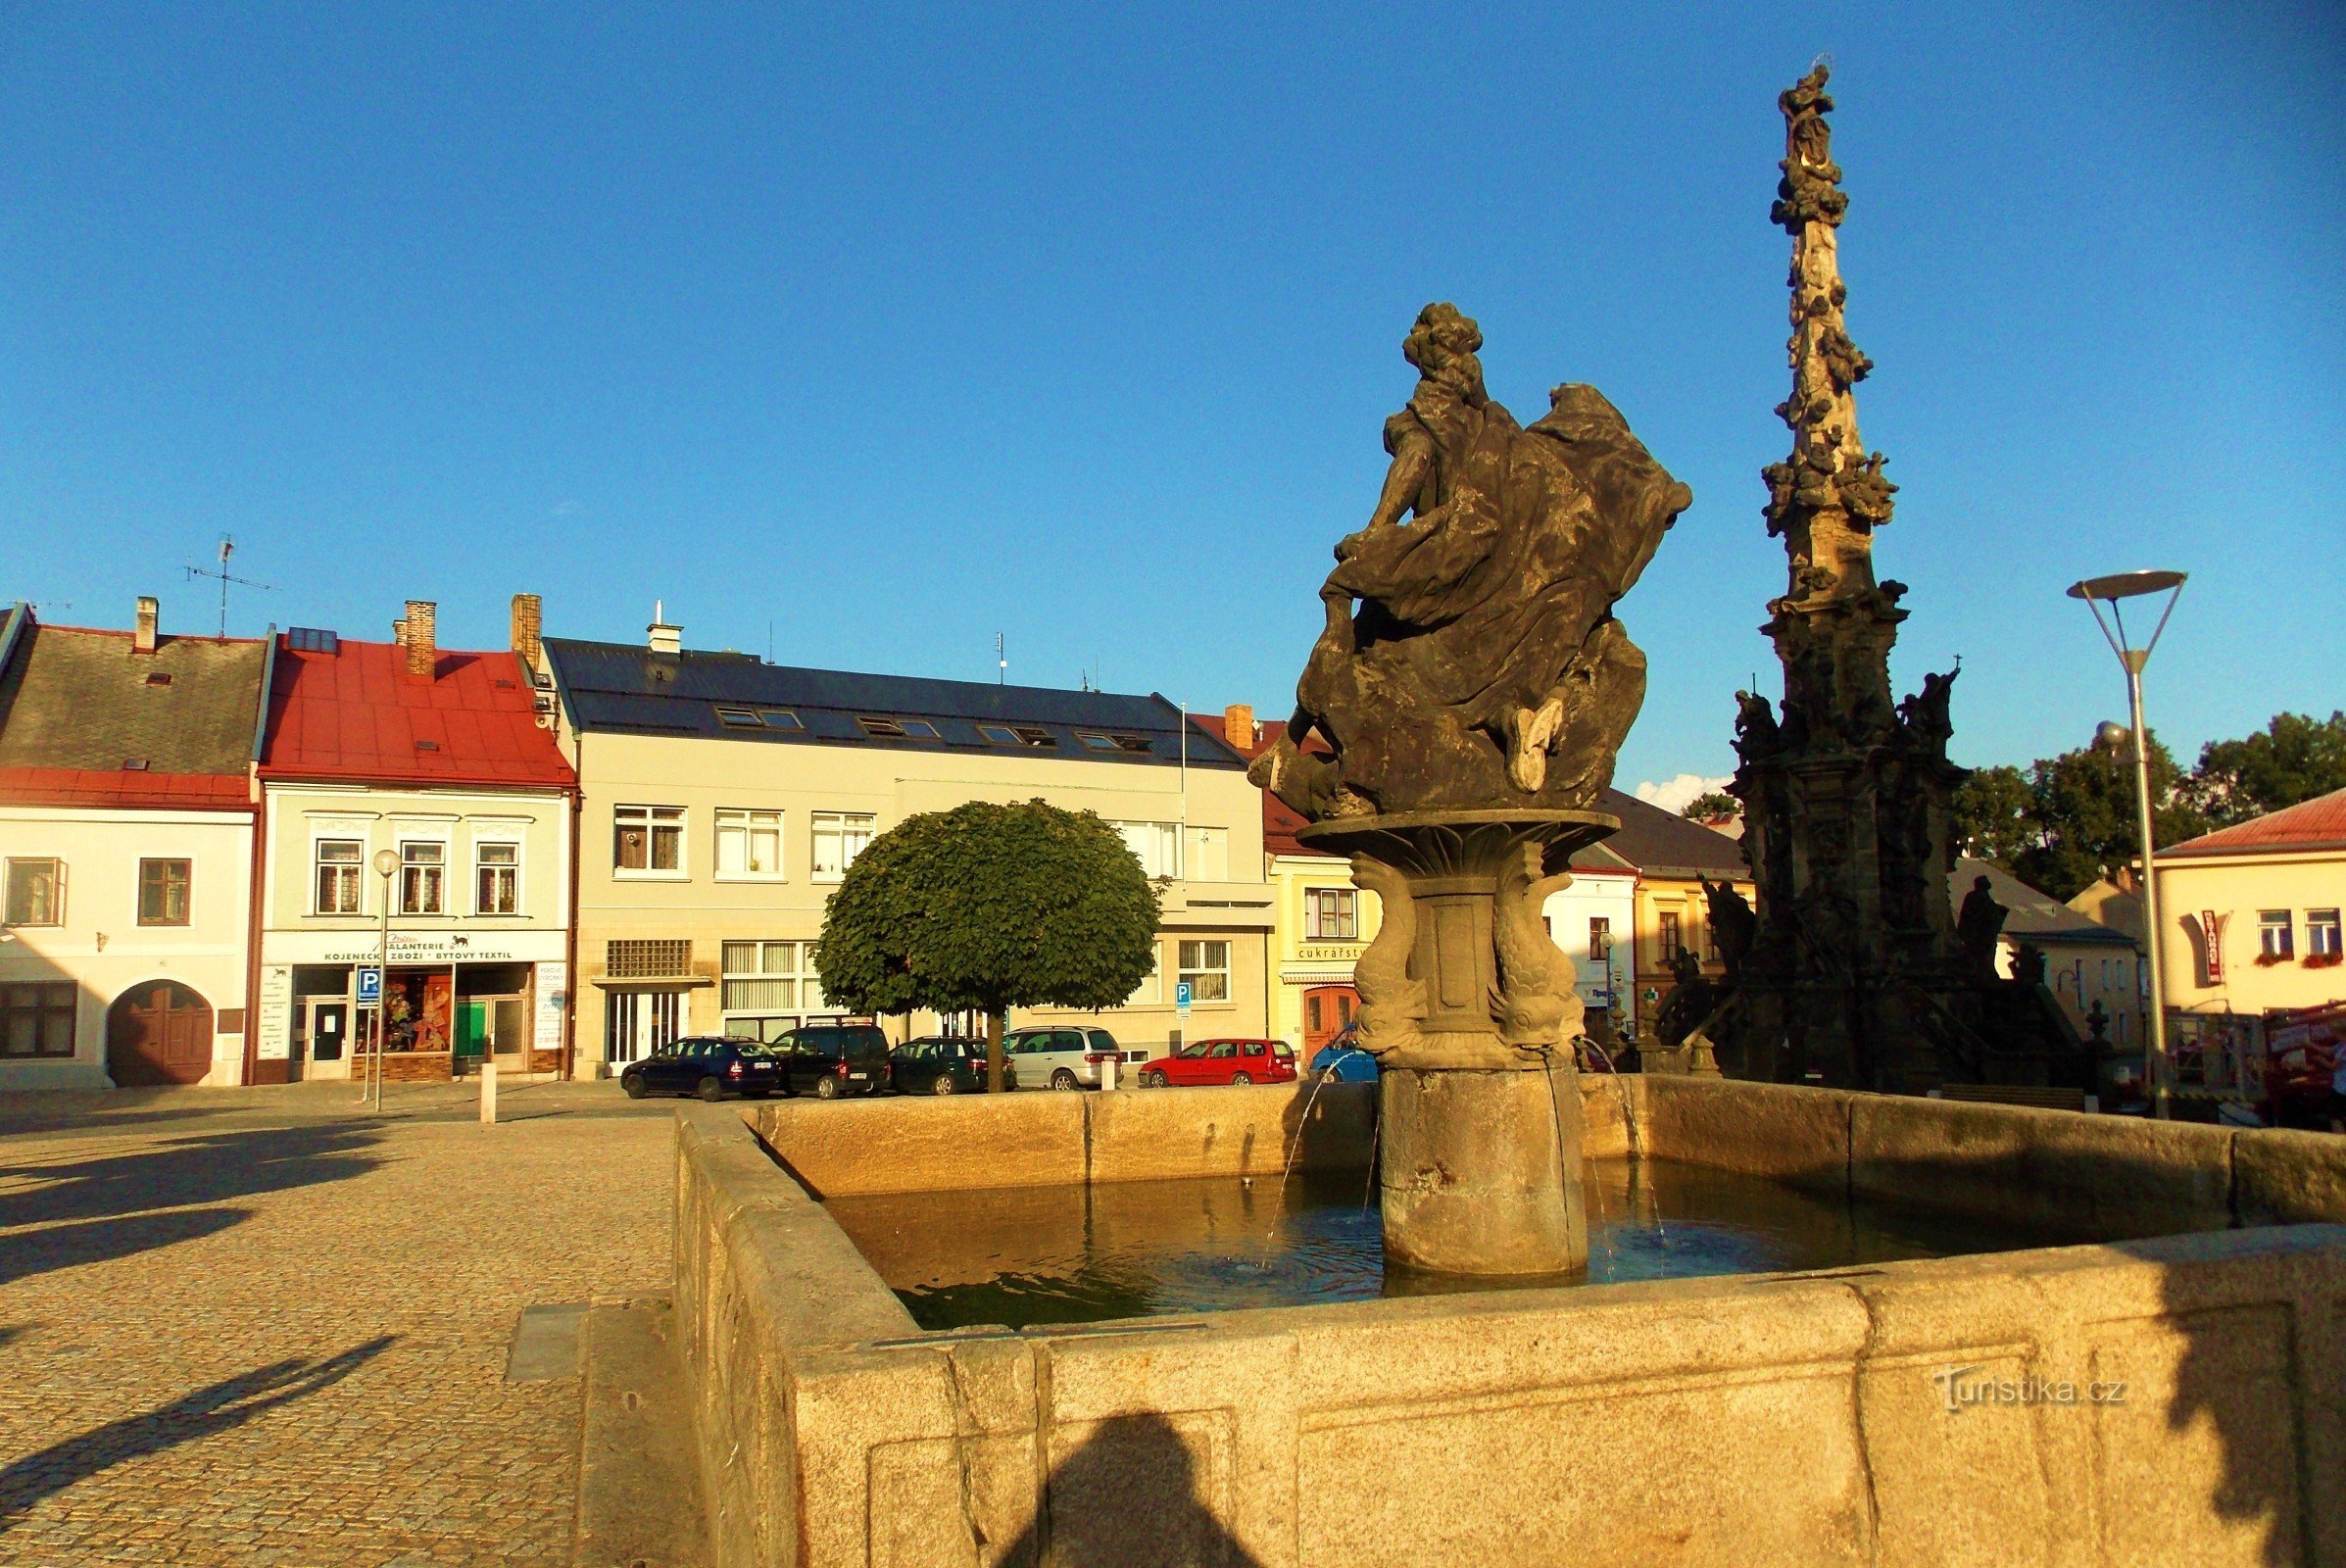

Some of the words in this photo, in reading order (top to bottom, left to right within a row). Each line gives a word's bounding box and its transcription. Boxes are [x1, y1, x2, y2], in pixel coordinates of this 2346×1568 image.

[1298, 947, 1365, 958] cukrářstv
[364, 972, 379, 991] P
[1178, 985, 1188, 1001] P
